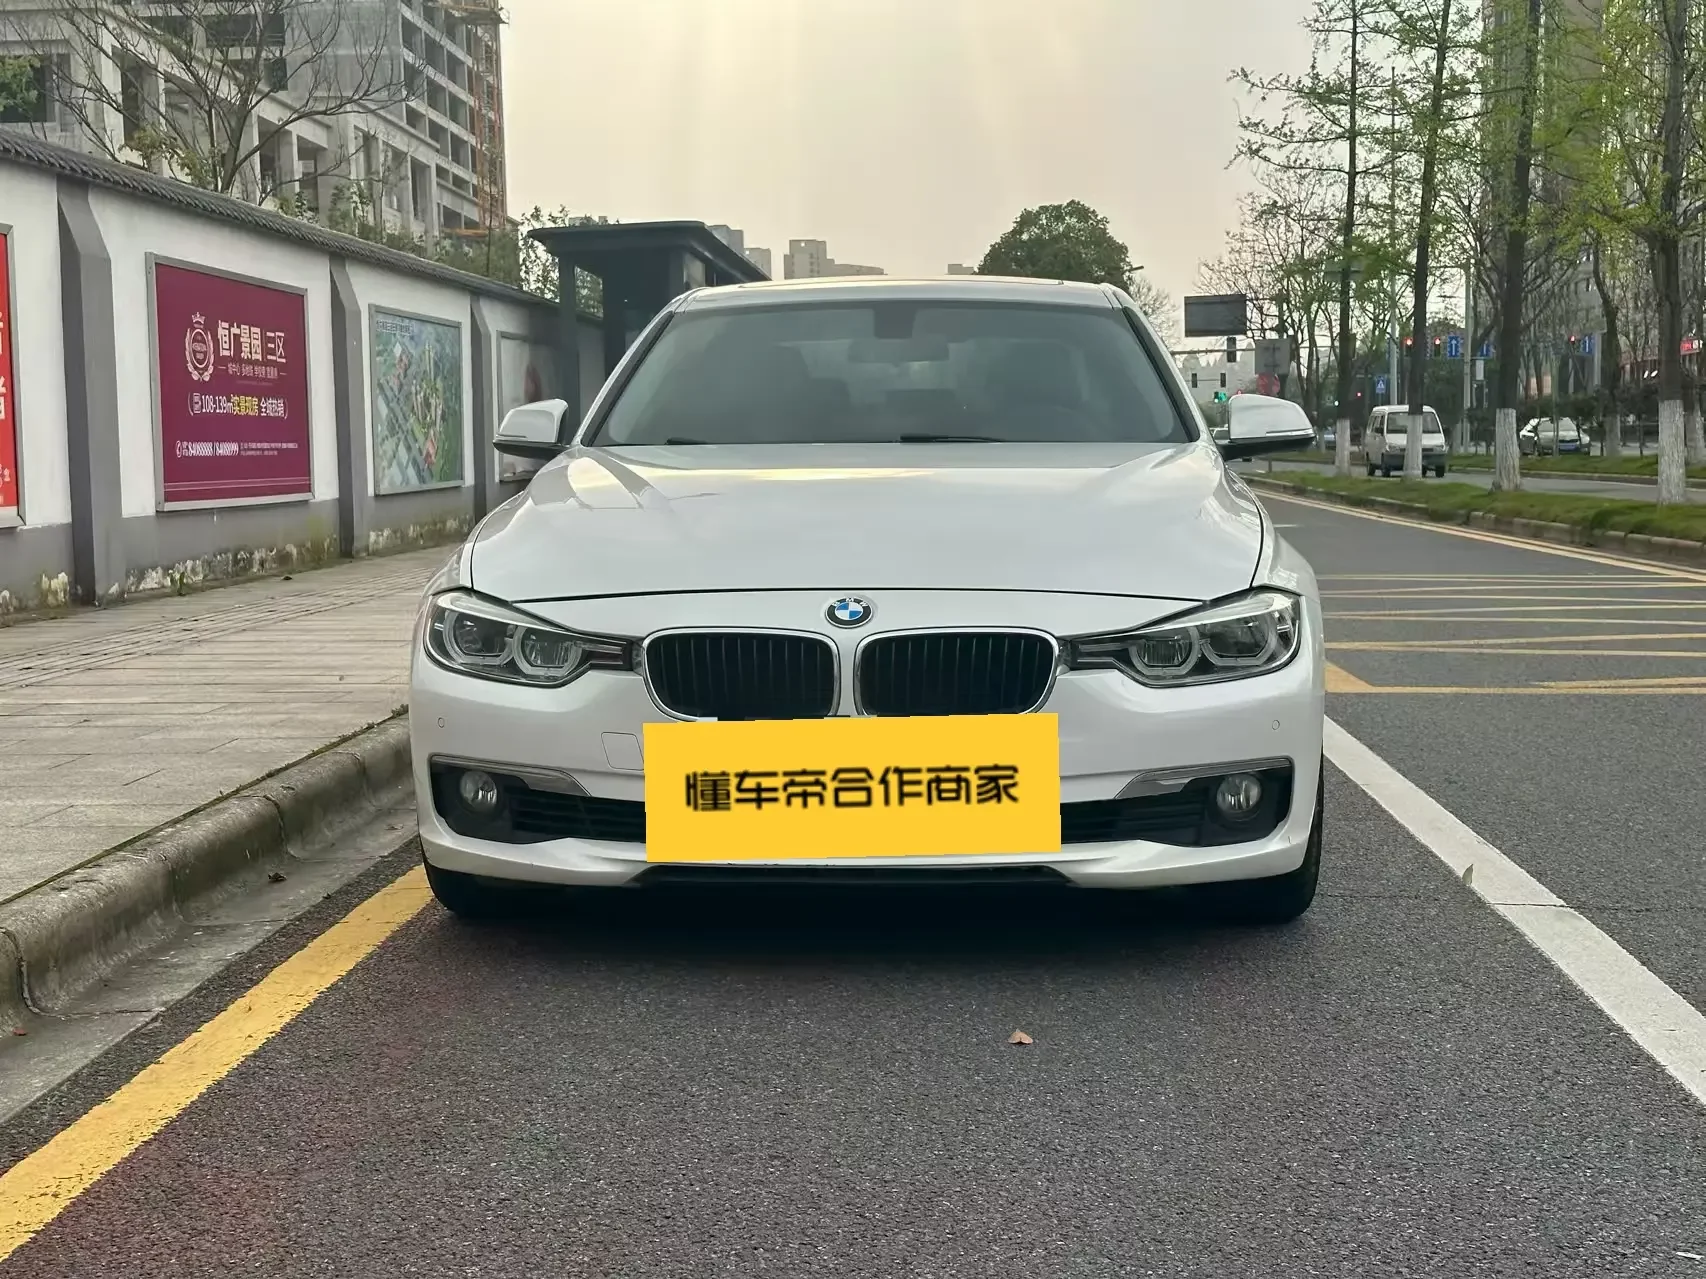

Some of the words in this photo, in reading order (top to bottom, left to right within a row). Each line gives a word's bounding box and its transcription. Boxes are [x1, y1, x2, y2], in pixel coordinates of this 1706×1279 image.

[217, 320, 262, 361] 恒广景园
[266, 331, 286, 363] 三区
